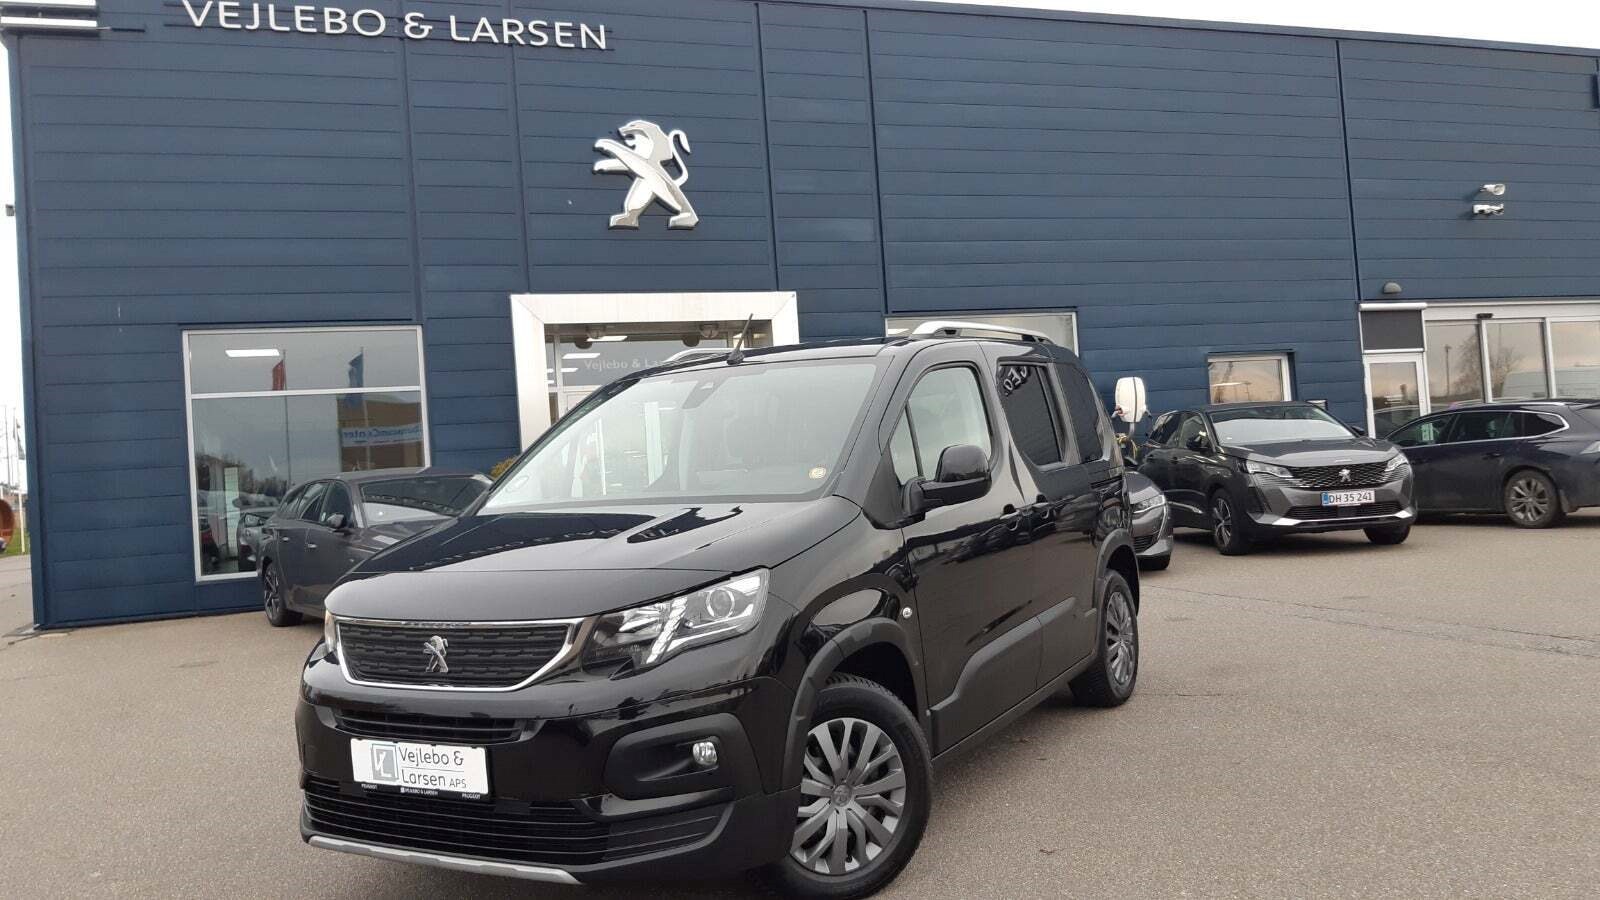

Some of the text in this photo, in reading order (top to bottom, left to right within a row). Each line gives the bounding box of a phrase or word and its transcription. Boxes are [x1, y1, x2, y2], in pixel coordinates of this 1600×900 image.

[182, 0, 607, 49] VEJLEBO & LARSEN
[584, 359, 628, 372] Vejlebo
[632, 359, 640, 369] &
[1329, 492, 1372, 503] DH 35 241
[399, 747, 464, 767] Vejlebo &
[402, 769, 467, 789] Larsen APS
